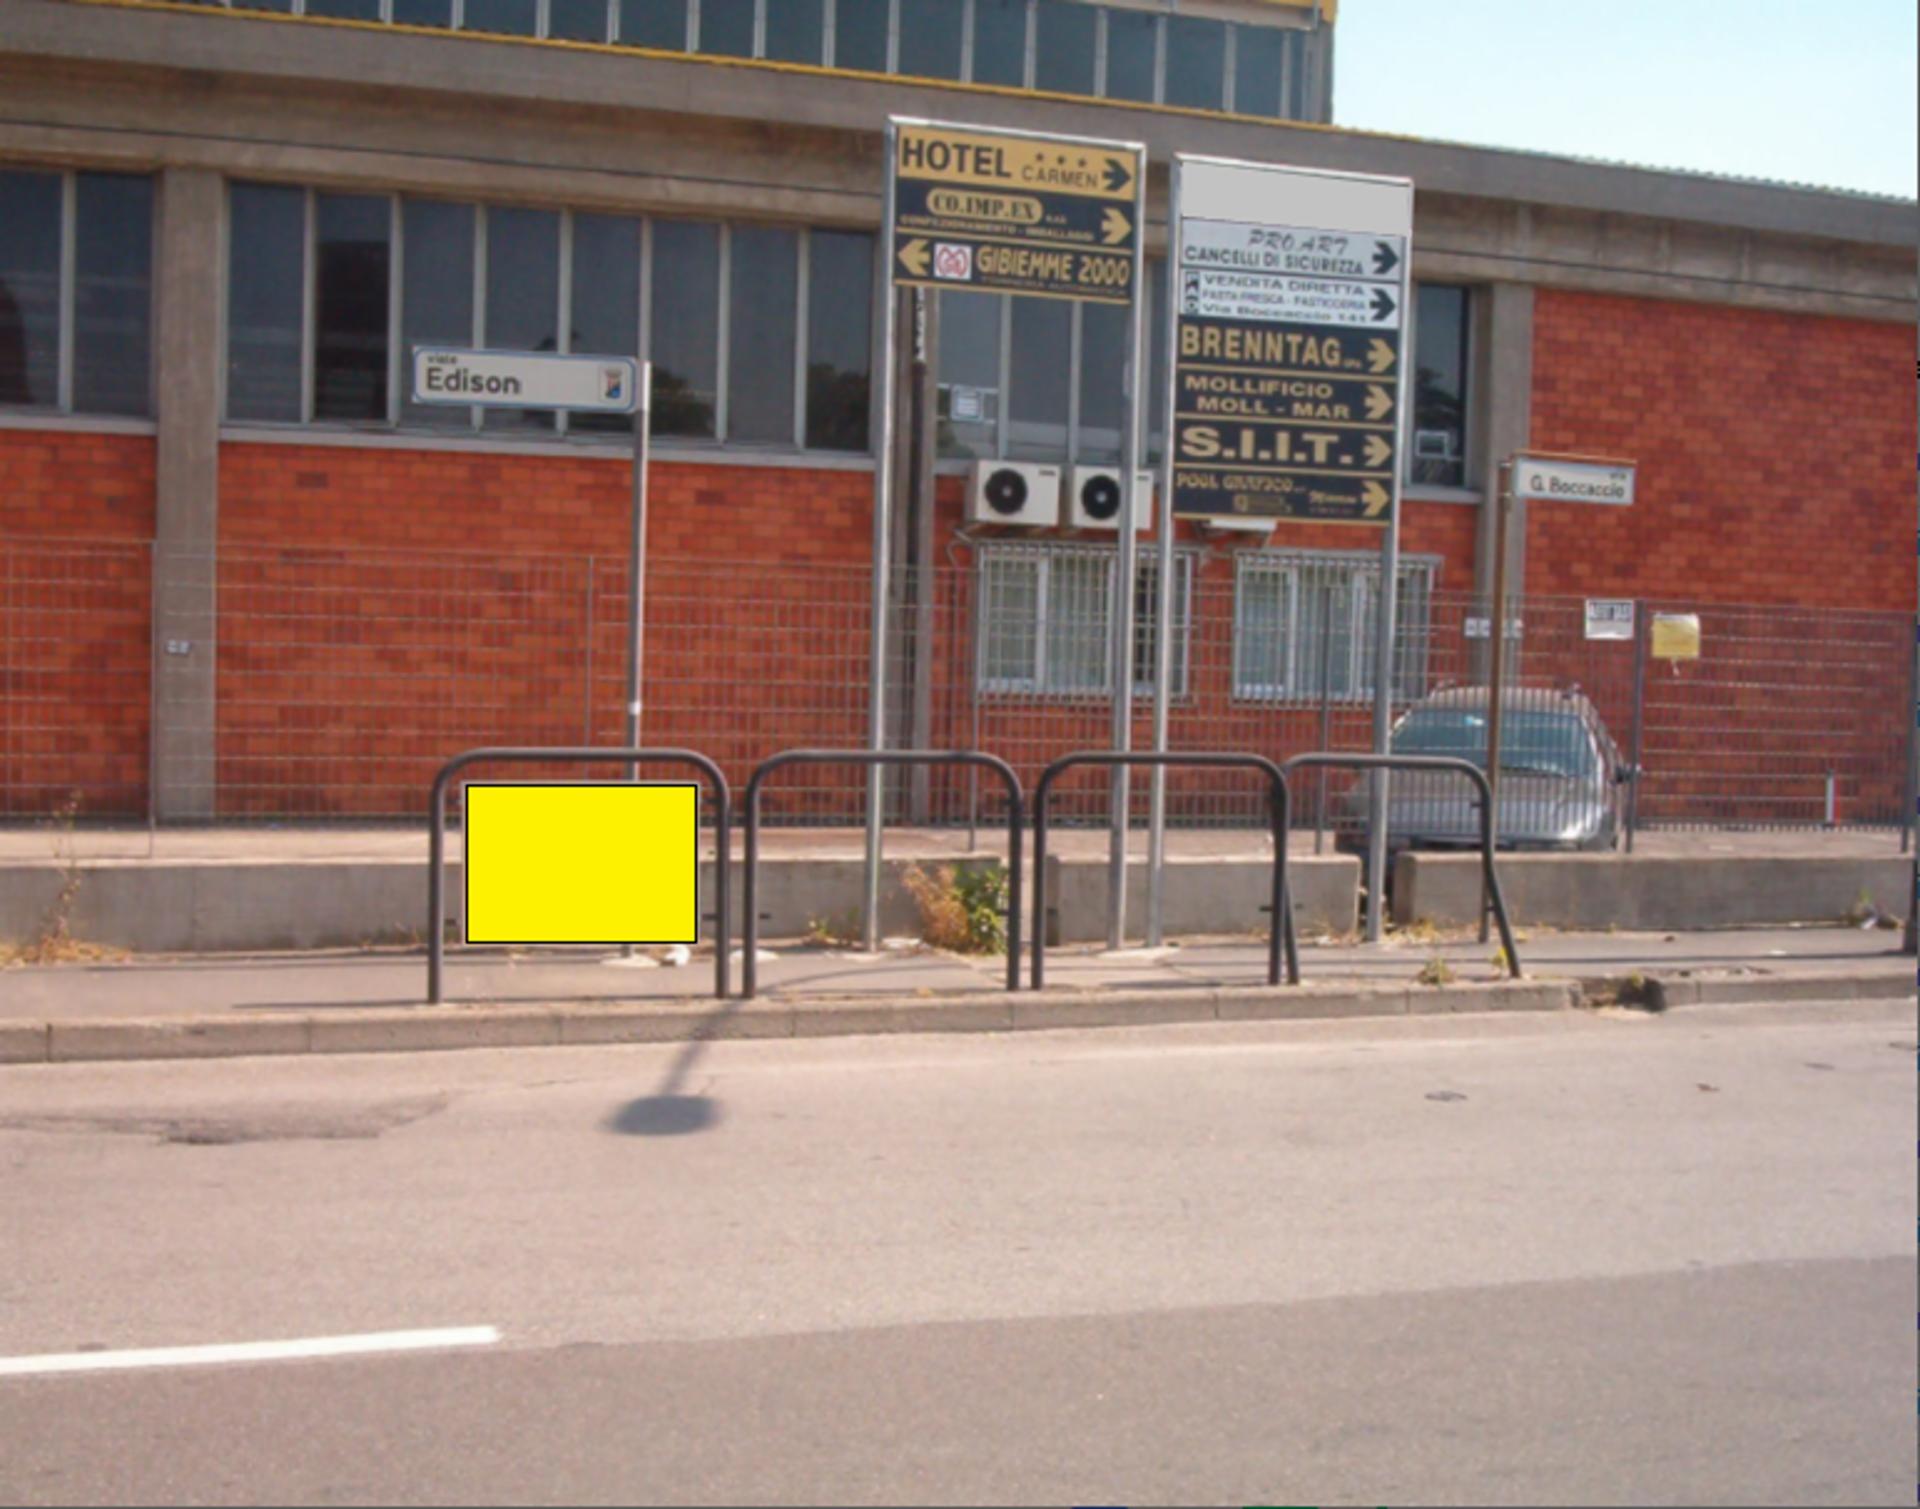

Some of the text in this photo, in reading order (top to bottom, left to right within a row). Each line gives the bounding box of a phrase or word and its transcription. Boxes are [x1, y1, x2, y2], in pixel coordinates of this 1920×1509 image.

[902, 137, 1012, 178] HOTEL
[1022, 165, 1098, 188] CARMEN
[1249, 229, 1349, 255] PRO ART
[976, 245, 1130, 287] GIBIEMME 2000
[1184, 245, 1364, 275] CANCELLI DI SICUREZZA
[1202, 289, 1237, 301] PASTA
[1240, 291, 1285, 304] FRESCA
[1203, 274, 1365, 296] VENDITA DIRETTA
[1203, 303, 1232, 314] Via
[1237, 306, 1332, 321] Boccaccio
[1181, 324, 1341, 367] BRENNTAG
[427, 354, 458, 365] viale
[426, 367, 521, 394] Edison
[1185, 376, 1333, 398] MOLLIFICIO
[1197, 396, 1269, 415] MOLL
[1293, 402, 1349, 419] MAR
[1181, 427, 1353, 464] S.I.I.T.
[1177, 472, 1219, 489] POOL
[1550, 476, 1625, 498] Boccaccio
